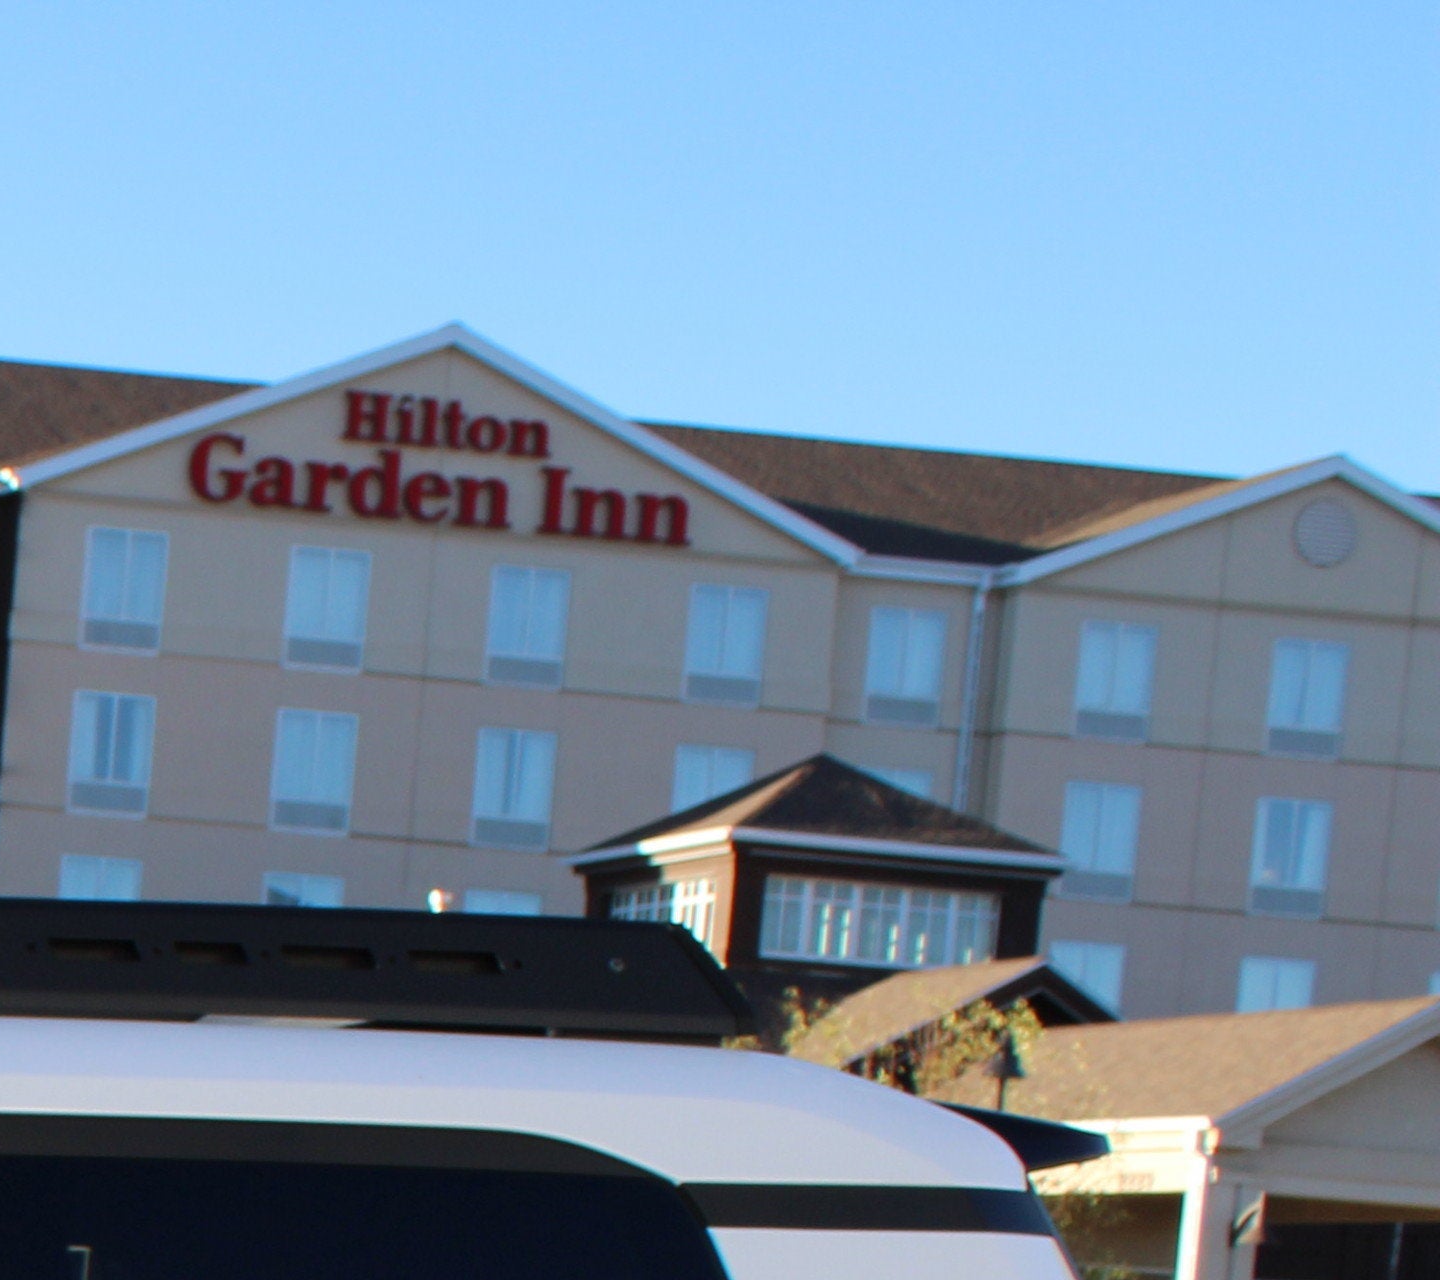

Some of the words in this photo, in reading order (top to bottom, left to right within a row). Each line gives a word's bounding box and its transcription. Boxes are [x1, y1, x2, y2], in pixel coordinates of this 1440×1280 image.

[343, 390, 551, 460] Hilton
[188, 432, 511, 529] Garden
[538, 466, 691, 547] Inn
